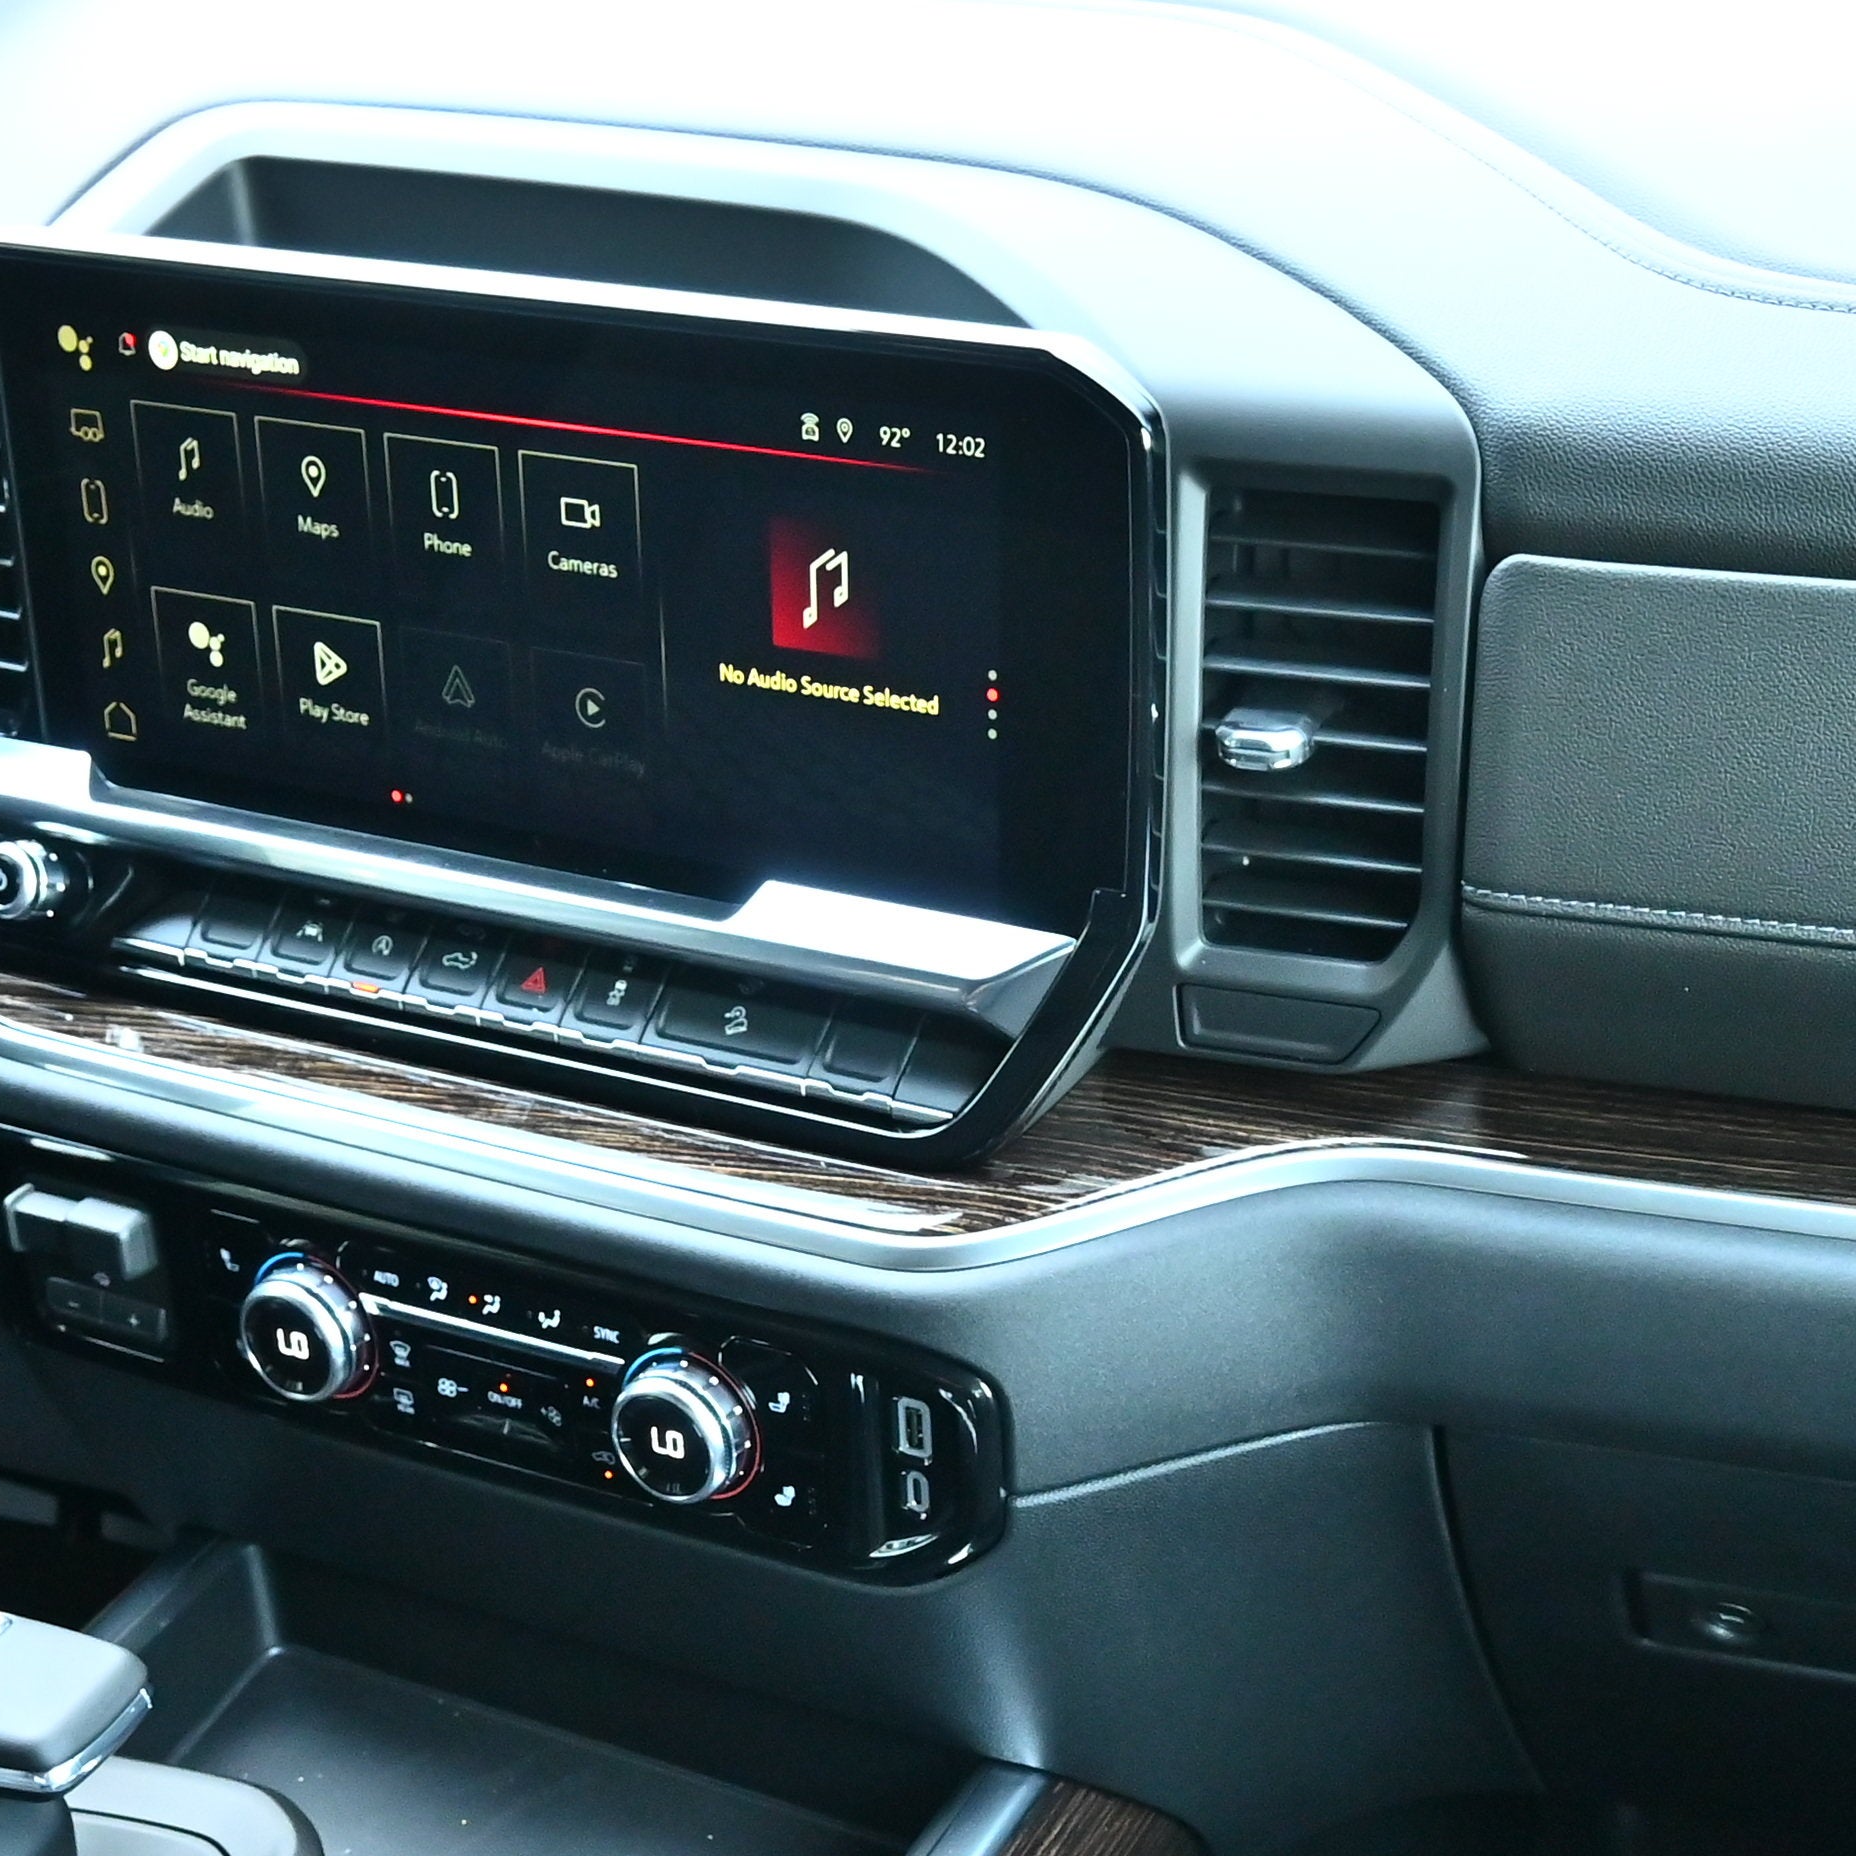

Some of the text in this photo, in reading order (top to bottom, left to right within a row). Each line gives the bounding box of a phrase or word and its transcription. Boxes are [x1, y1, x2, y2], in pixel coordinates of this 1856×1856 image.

[179, 340, 300, 375] Start navigation
[936, 432, 986, 458] 12:02
[172, 497, 215, 521] Audio
[297, 513, 340, 540] Maps
[423, 532, 472, 557] Phone
[547, 550, 619, 579] Cameras
[186, 678, 237, 707] Google
[719, 662, 940, 716] No Audio Source Selected
[183, 703, 248, 730] Assistant
[299, 697, 370, 726] Play Store
[593, 1325, 621, 1344] SYNC
